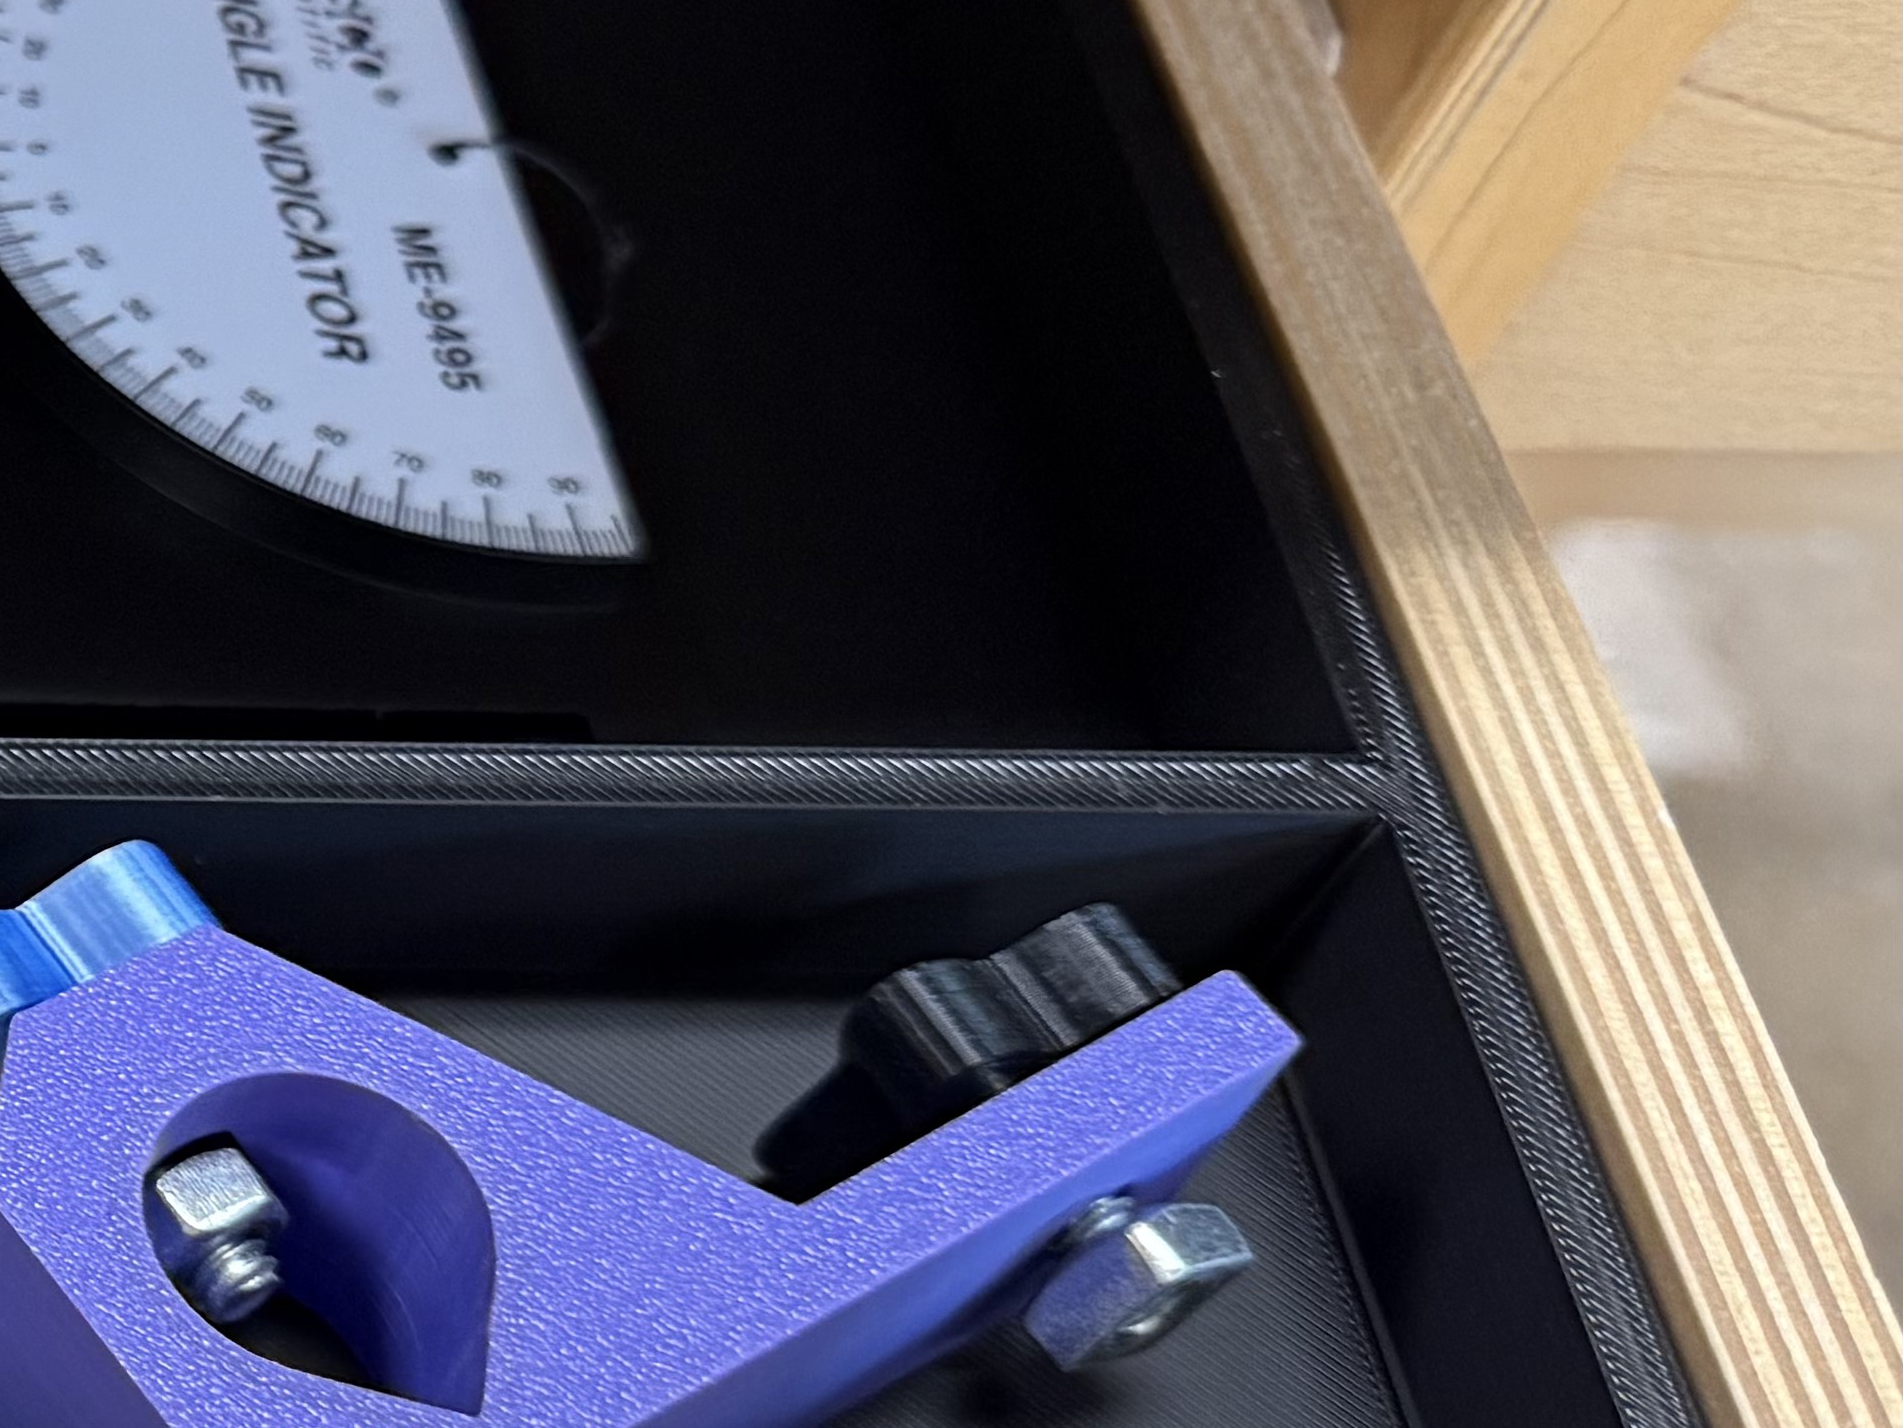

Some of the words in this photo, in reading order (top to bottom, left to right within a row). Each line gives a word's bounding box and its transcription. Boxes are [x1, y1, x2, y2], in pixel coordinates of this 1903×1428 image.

[46, 190, 70, 216] 10
[245, 104, 370, 366] INDICATOR
[391, 223, 484, 394] ME-9495
[241, 385, 274, 413] 50
[313, 423, 347, 448] 60
[393, 450, 425, 474] 70
[470, 468, 503, 489] 80
[546, 475, 580, 495] 90
